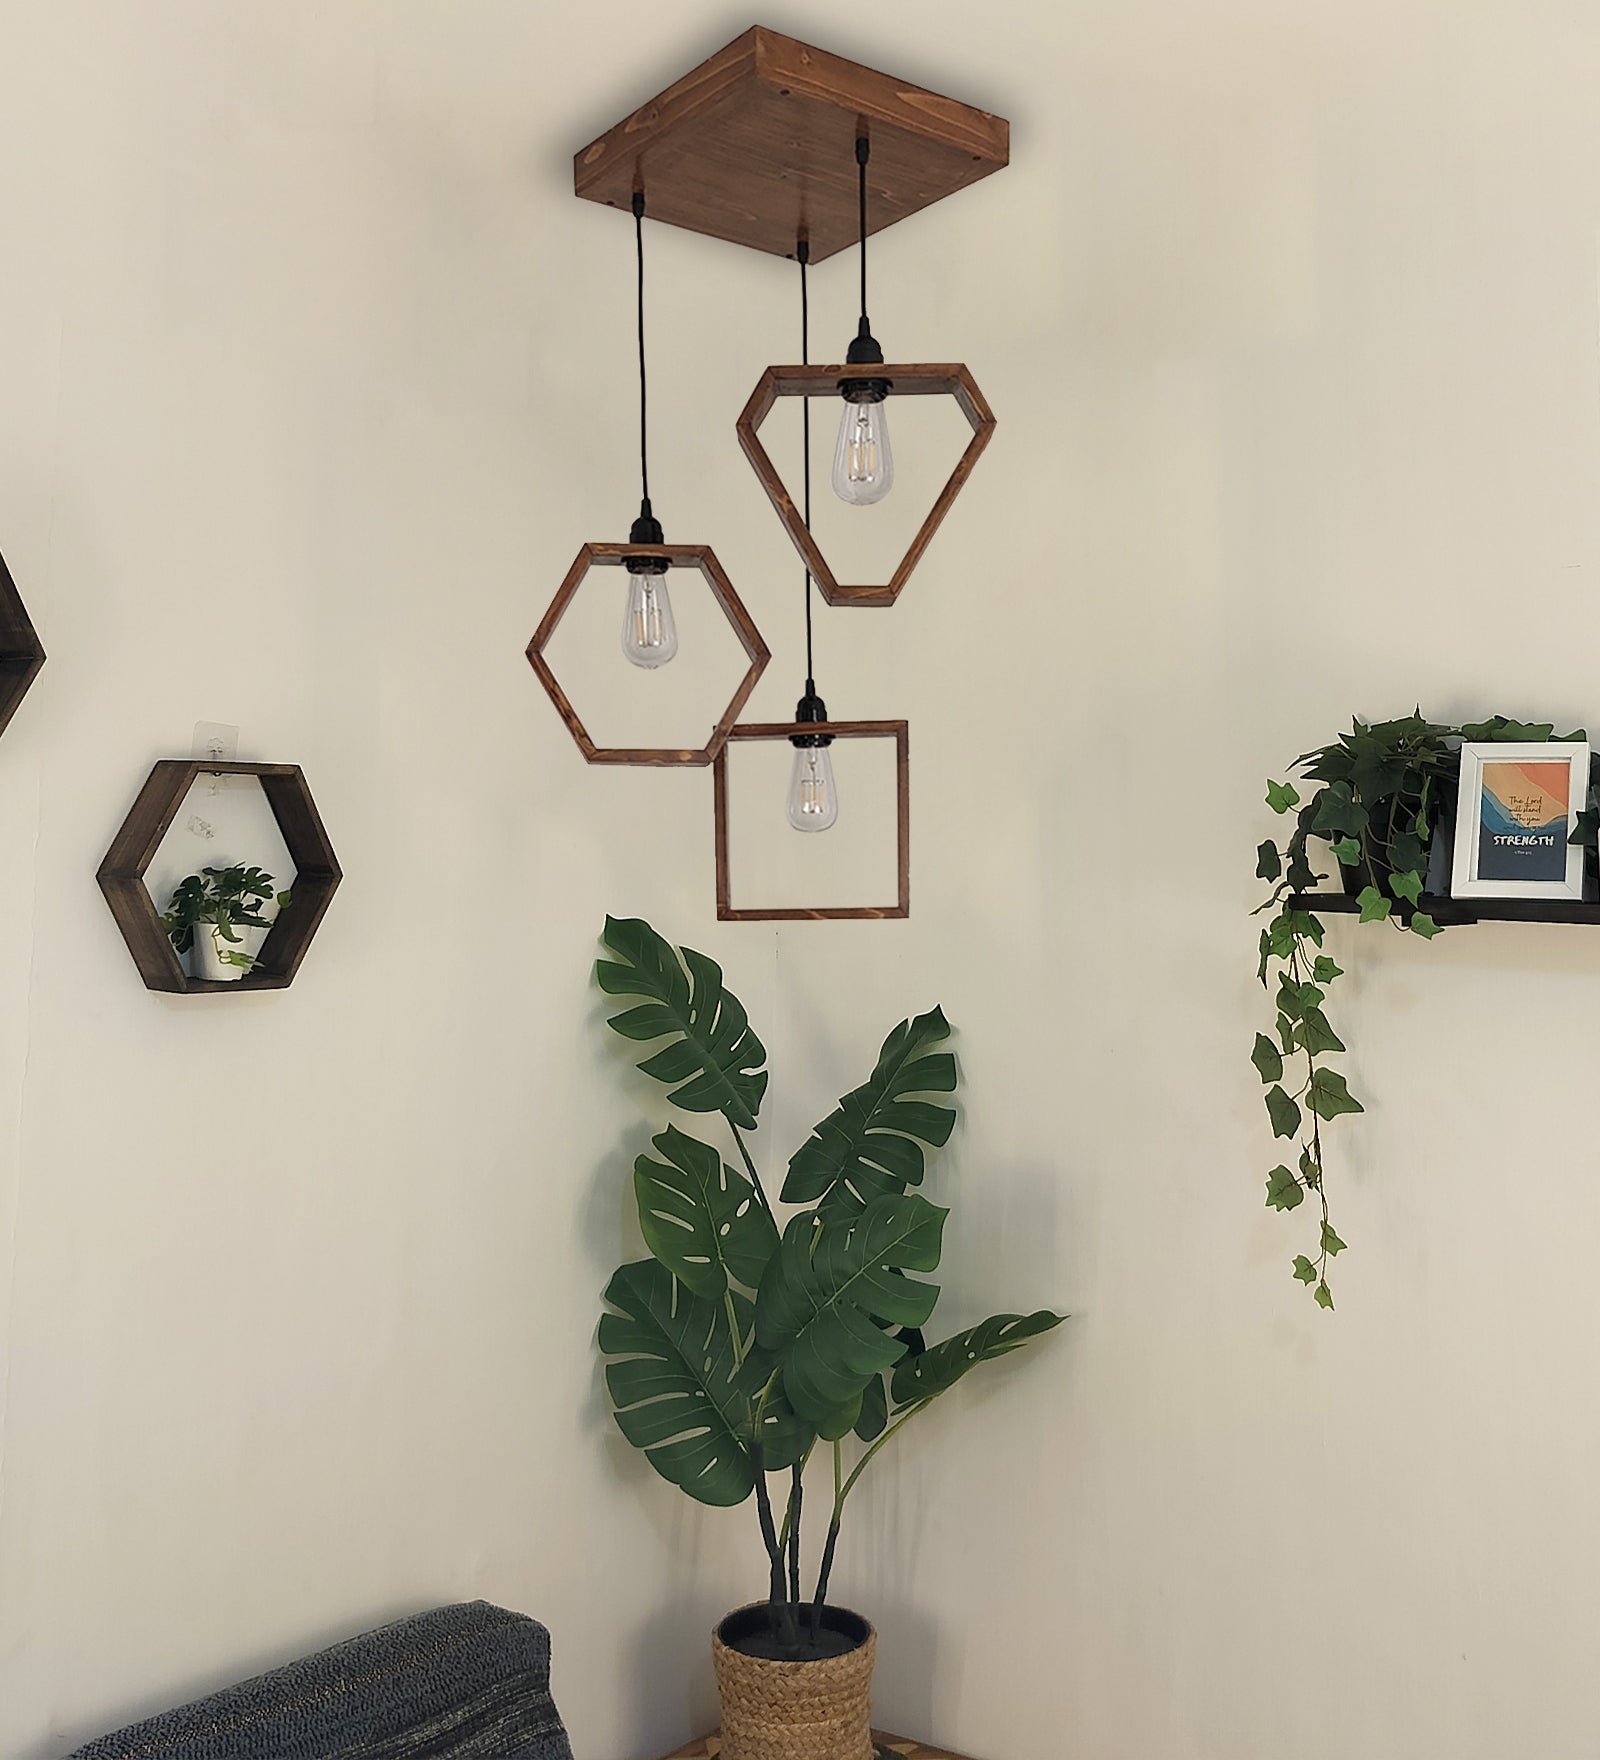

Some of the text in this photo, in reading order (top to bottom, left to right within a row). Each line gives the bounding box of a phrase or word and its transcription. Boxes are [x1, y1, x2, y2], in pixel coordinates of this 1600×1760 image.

[1508, 796, 1542, 805] The Lord
[1523, 804, 1541, 813] stand
[1526, 817, 1541, 826] you
[1493, 835, 1554, 846] STRENGTH
